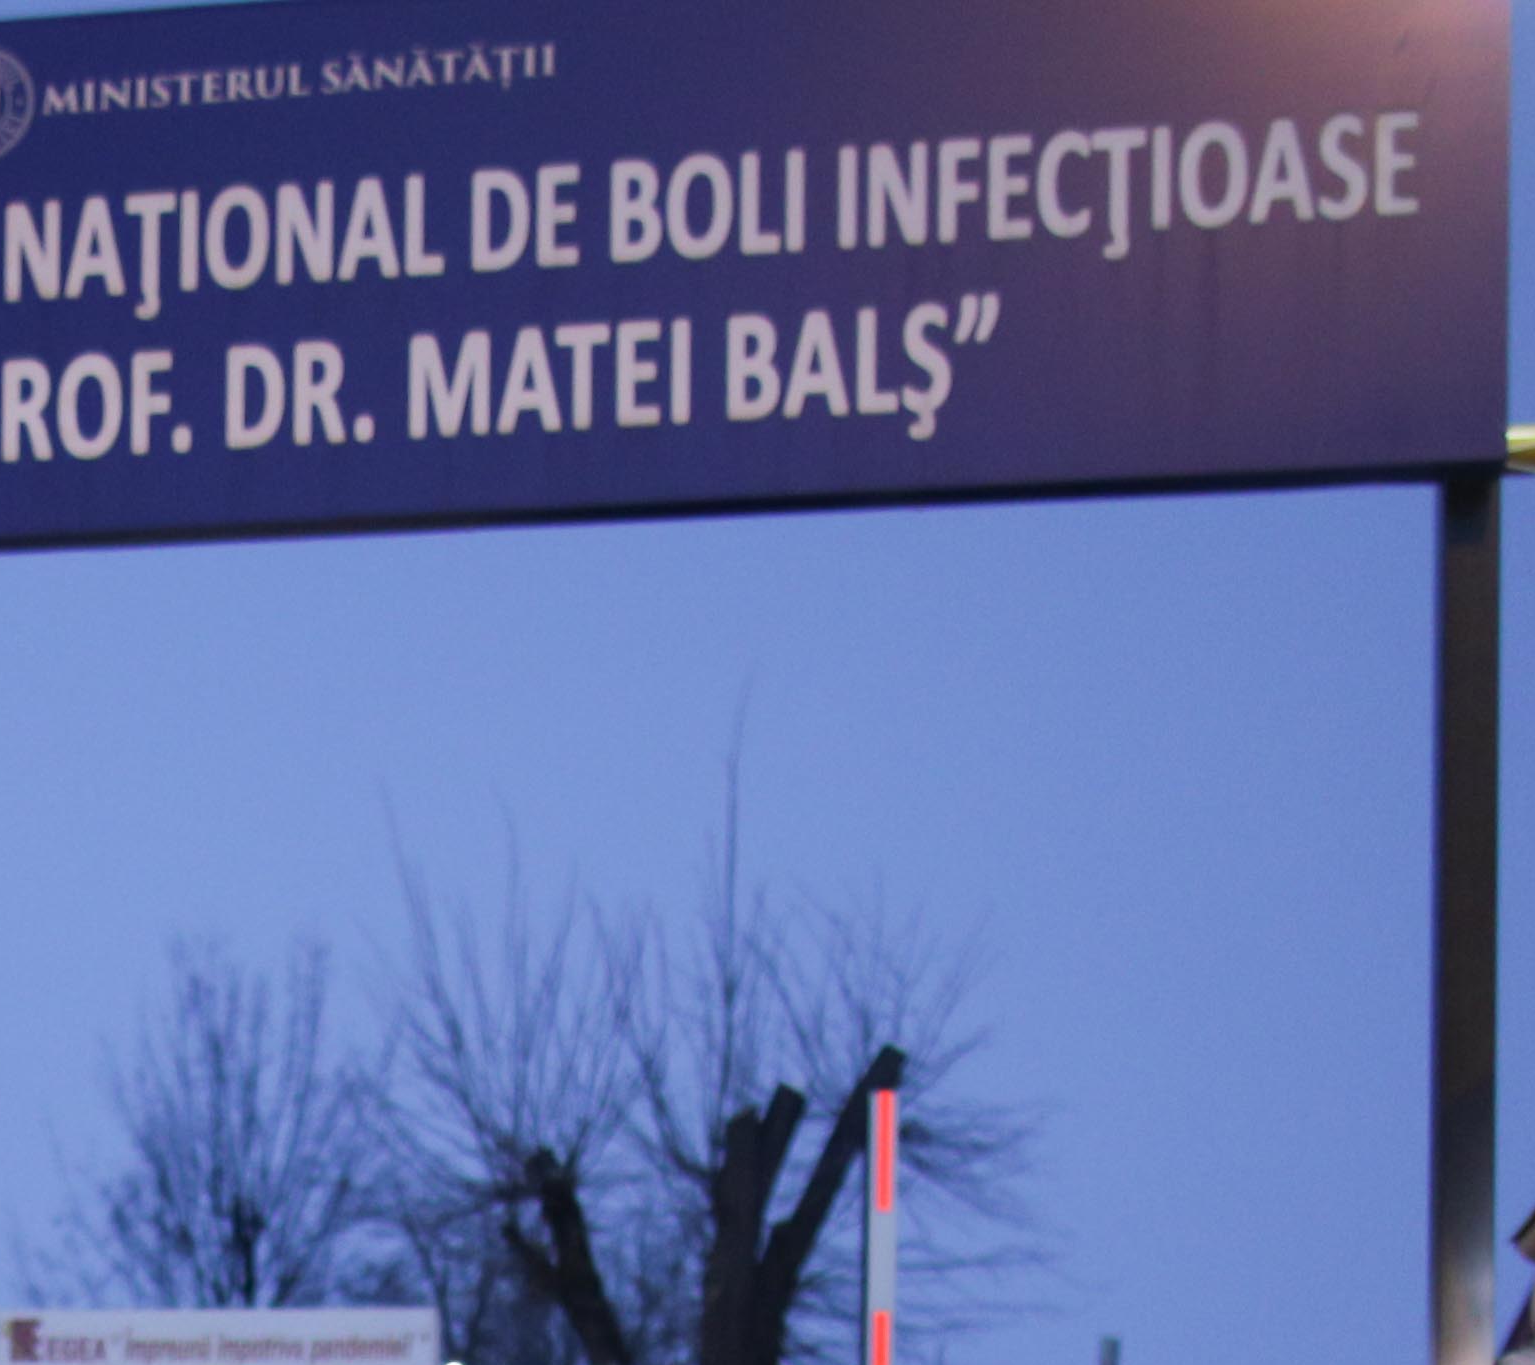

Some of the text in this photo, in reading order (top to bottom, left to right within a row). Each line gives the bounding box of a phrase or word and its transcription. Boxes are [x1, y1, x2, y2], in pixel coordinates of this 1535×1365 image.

[43, 66, 309, 115] MINISTERUL
[470, 162, 581, 273] DE
[608, 148, 806, 263] BOLI
[224, 339, 375, 451] DR.
[407, 317, 692, 441] MATEI
